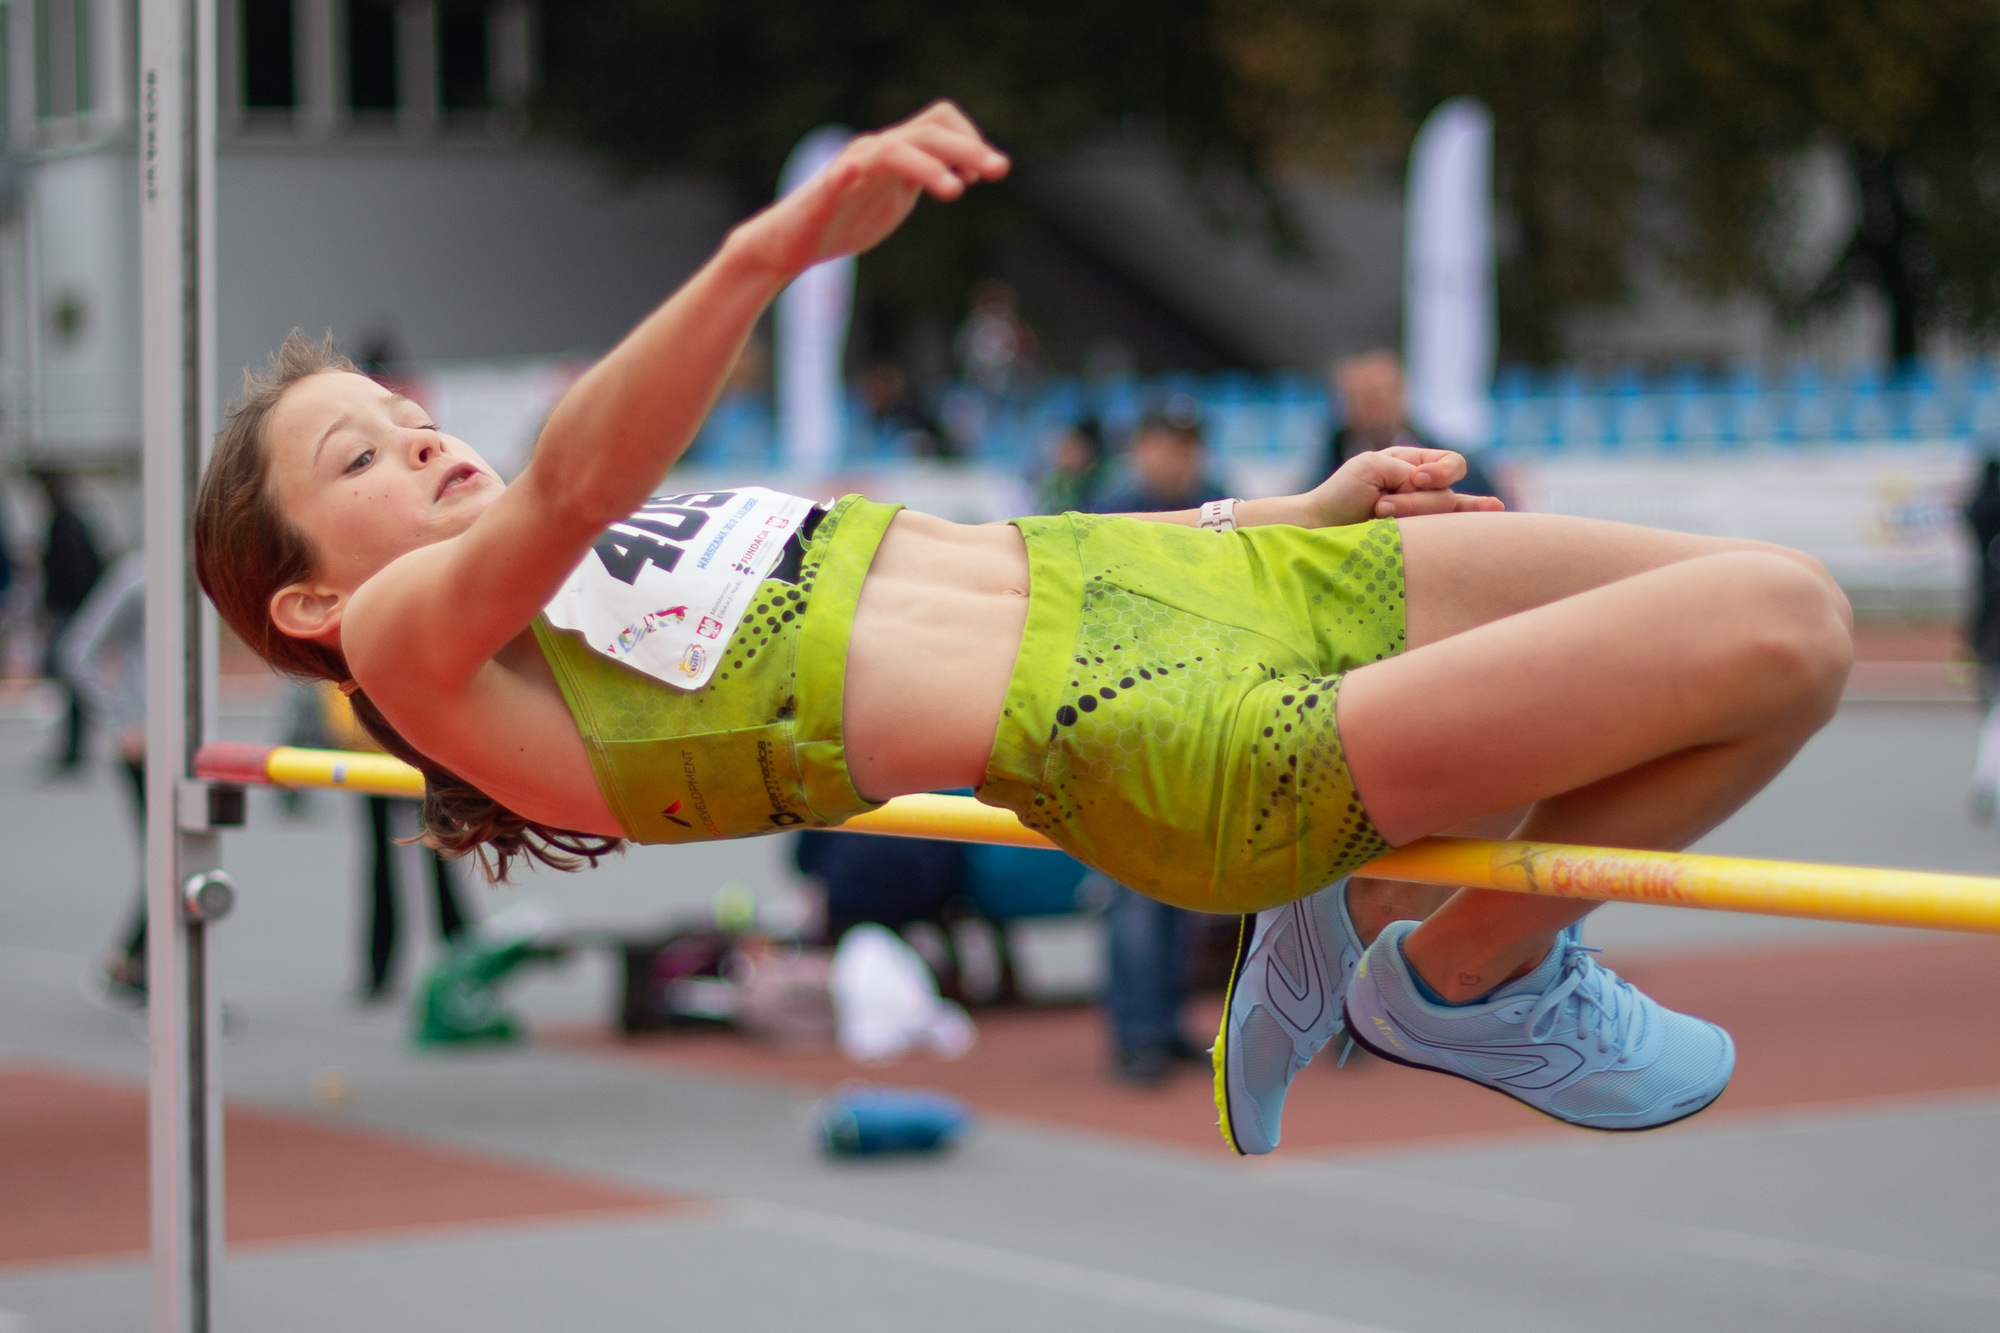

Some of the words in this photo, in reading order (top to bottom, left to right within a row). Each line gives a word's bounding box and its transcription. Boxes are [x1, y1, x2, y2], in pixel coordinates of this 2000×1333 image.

[696, 530, 729, 570] WARSZAWA
[741, 529, 771, 565] FUNDACJA
[689, 649, 700, 672] LOTTO
